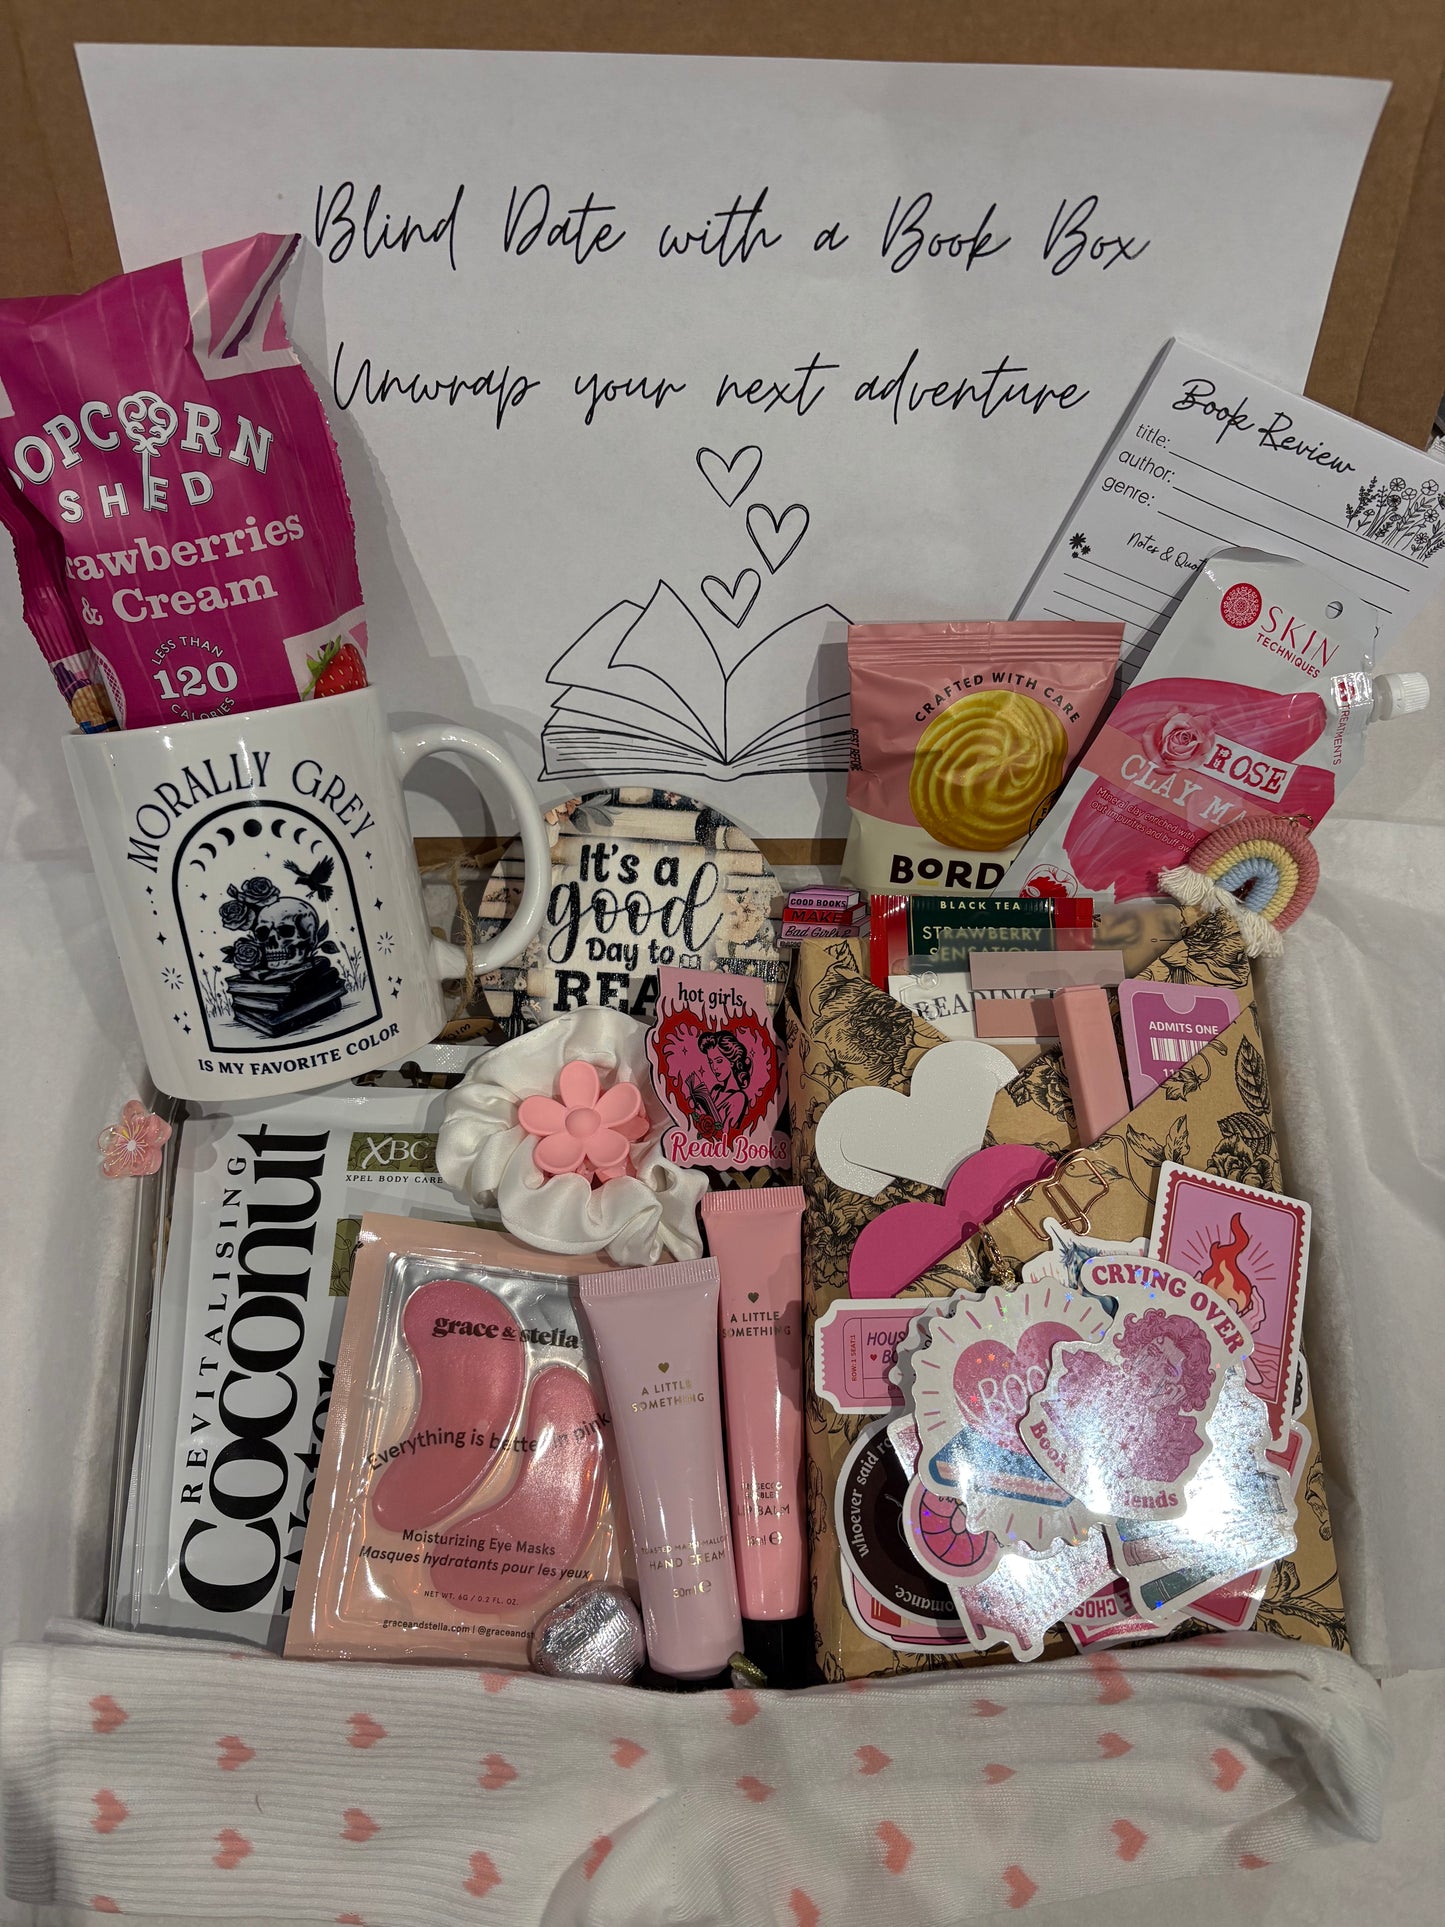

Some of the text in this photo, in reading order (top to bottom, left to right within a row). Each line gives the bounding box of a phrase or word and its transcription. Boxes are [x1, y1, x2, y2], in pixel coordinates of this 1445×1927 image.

[316, 182, 1150, 276] Blind Date with a Book Box
[334, 342, 1089, 429] Unwrap your next adventure
[8, 390, 273, 492] OPCORN
[1135, 422, 1171, 449] title:
[1172, 379, 1356, 473] Book Review
[1118, 448, 1175, 483] author:
[58, 470, 215, 524] SHED
[1101, 475, 1155, 507] genre:
[65, 514, 304, 581] rawberries
[1127, 532, 1159, 554] Notes
[1160, 546, 1175, 562] &
[81, 573, 279, 626] & Cream
[152, 636, 223, 665] LESS THAN
[1260, 605, 1340, 667] SKIN
[1256, 632, 1320, 679] TECHNIQUES
[153, 661, 238, 699] 120
[915, 672, 1081, 724] CRAFTED WITH CARE
[1332, 703, 1351, 766] TREATMENTS
[1120, 754, 1202, 807] CLAY
[1203, 743, 1288, 794] ROSE
[126, 751, 376, 874] MORALLY GREY
[1091, 801, 1107, 814] out
[1106, 808, 1146, 832] impurities
[1145, 827, 1162, 839] and
[1162, 834, 1179, 847] buff
[1096, 786, 1196, 842] Mineral clay enriched with
[579, 842, 680, 887] It's a
[889, 854, 1010, 890] BORD
[546, 861, 724, 964] good
[791, 910, 843, 923] MAKE
[816, 899, 847, 908] BOOKS
[940, 900, 1021, 911] BLACK TEA
[785, 925, 811, 937] Bad
[922, 925, 1042, 941] STRAWBERRY
[585, 937, 675, 971] Day to
[552, 969, 660, 1015] REA
[678, 981, 743, 1009] hot girls
[1149, 1020, 1219, 1035] ADMITS ONE
[198, 1021, 401, 1076] IS MY FAVORITE COLOR
[361, 1136, 430, 1169] XBC
[670, 1131, 787, 1164] Read Books
[345, 1174, 444, 1184] XPEL BODY CARE
[730, 1310, 780, 1323] A LITTLE
[1091, 1263, 1245, 1355] CRYING OVER
[180, 1154, 247, 1505] REVITALISING
[432, 1317, 579, 1349] grace & stella
[722, 1325, 792, 1338] SOMETHING
[866, 1331, 906, 1346] HOUS
[178, 1123, 331, 1615] Coconut
[631, 1392, 705, 1413] SOMETHING
[641, 1379, 692, 1396] A LITTLE
[366, 1427, 466, 1471] Everything
[470, 1428, 485, 1447] is
[857, 1450, 879, 1486] said
[758, 1503, 790, 1516] BALM
[402, 1529, 556, 1556] Moisturizing Eye Masks
[359, 1546, 590, 1581] Masques hydratants pour les yeux
[649, 1550, 726, 1571] HAND CREAM
[424, 1590, 439, 1598] NET
[441, 1591, 455, 1600] WT.
[477, 1595, 491, 1603] 0.2
[492, 1596, 504, 1604] FL.
[506, 1597, 520, 1606] OZ.
[894, 1584, 955, 1613] omance.
[382, 1617, 470, 1634] graceandstella.com
